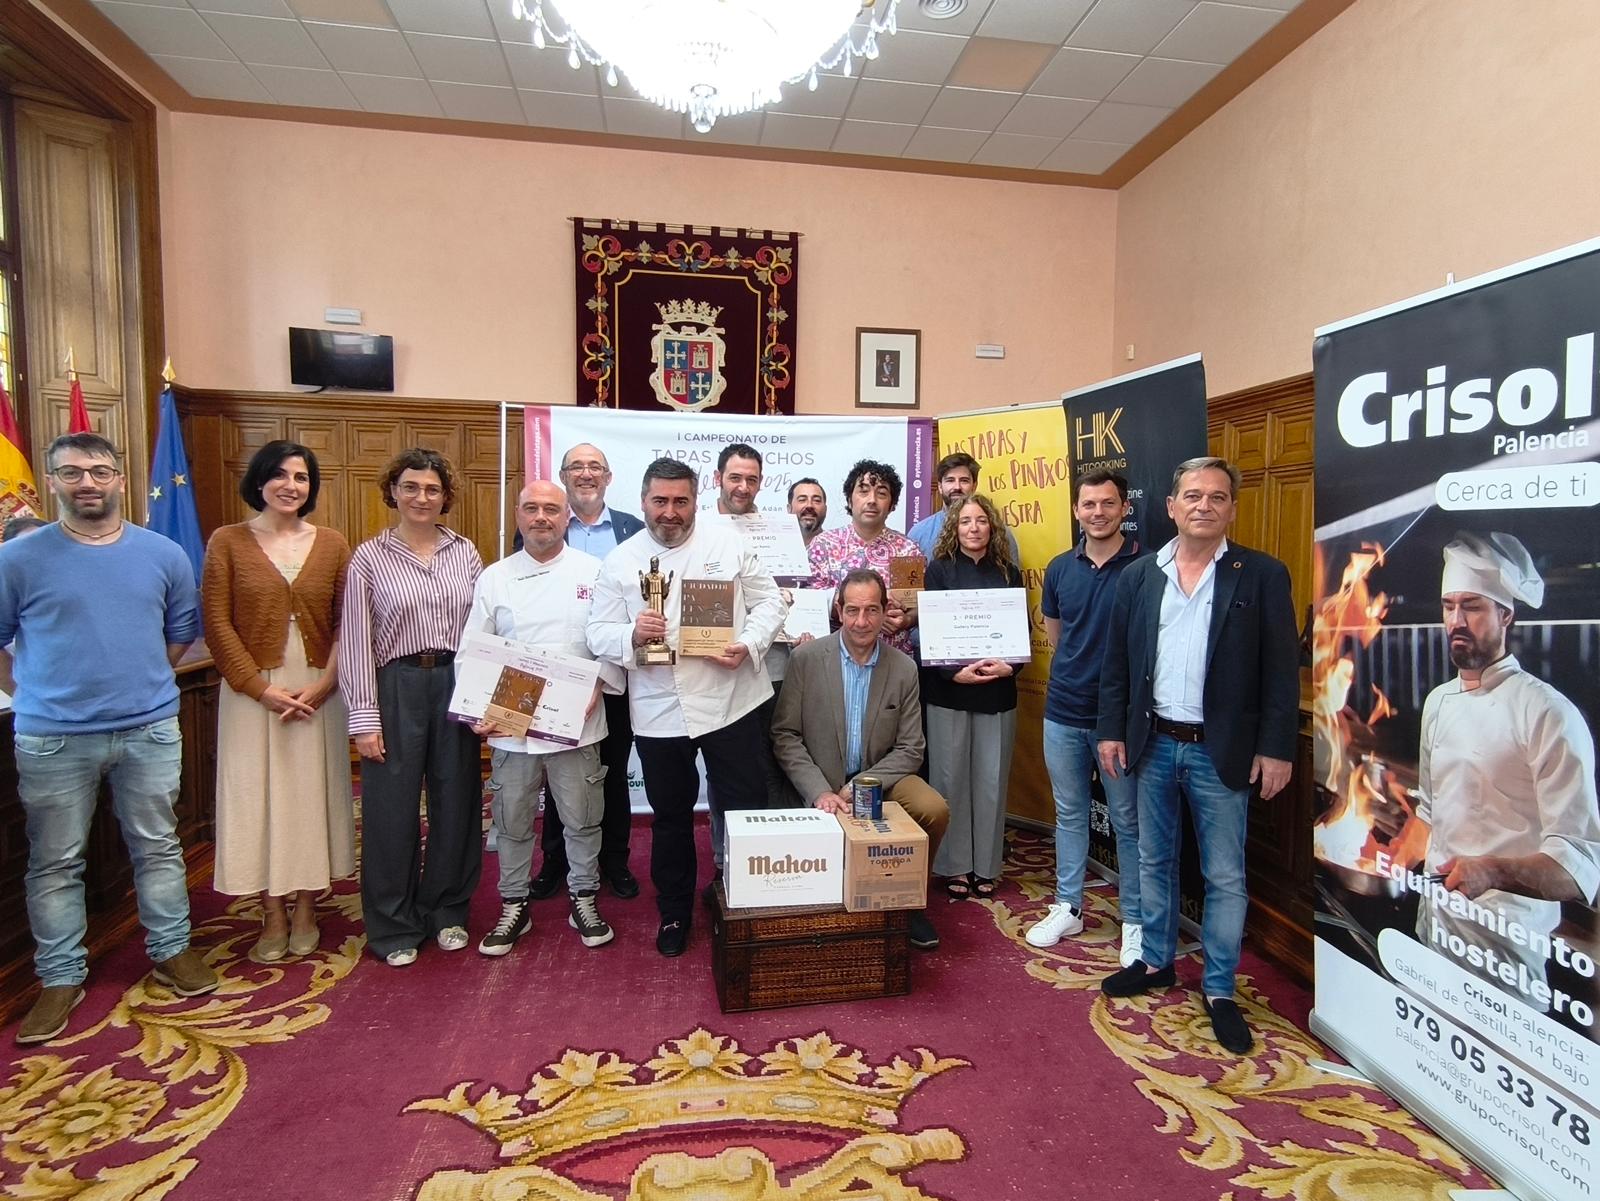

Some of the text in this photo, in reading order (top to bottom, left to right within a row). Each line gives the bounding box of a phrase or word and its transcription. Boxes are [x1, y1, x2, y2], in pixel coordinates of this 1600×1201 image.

[1337, 332, 1595, 448] Crisol
[684, 432, 768, 444] CAMPEONATO
[771, 435, 787, 444] DE
[967, 428, 1015, 460] TAPAS
[1018, 431, 1027, 454] Y
[1076, 407, 1126, 461] HK
[1493, 425, 1589, 455] Palencia
[652, 449, 712, 464] TAPAS
[988, 473, 1007, 492] LOS
[1446, 472, 1588, 503] Cerca de ti
[744, 814, 823, 824] Mahou
[747, 854, 829, 876] Mahou
[867, 843, 915, 858] Mahou
[1376, 850, 1596, 978] Equipamiento
[1431, 916, 1594, 1027] hostelero
[1394, 957, 1590, 1087] Gabriel de Castilla, 14 bajo
[1463, 982, 1591, 1066] Crisol Palencia:
[1394, 995, 1592, 1147] 979 05 33 78
[1395, 1025, 1592, 1172] palencia@grupocrisol.com
[1416, 1058, 1591, 1195] www.grupocrisol.com
